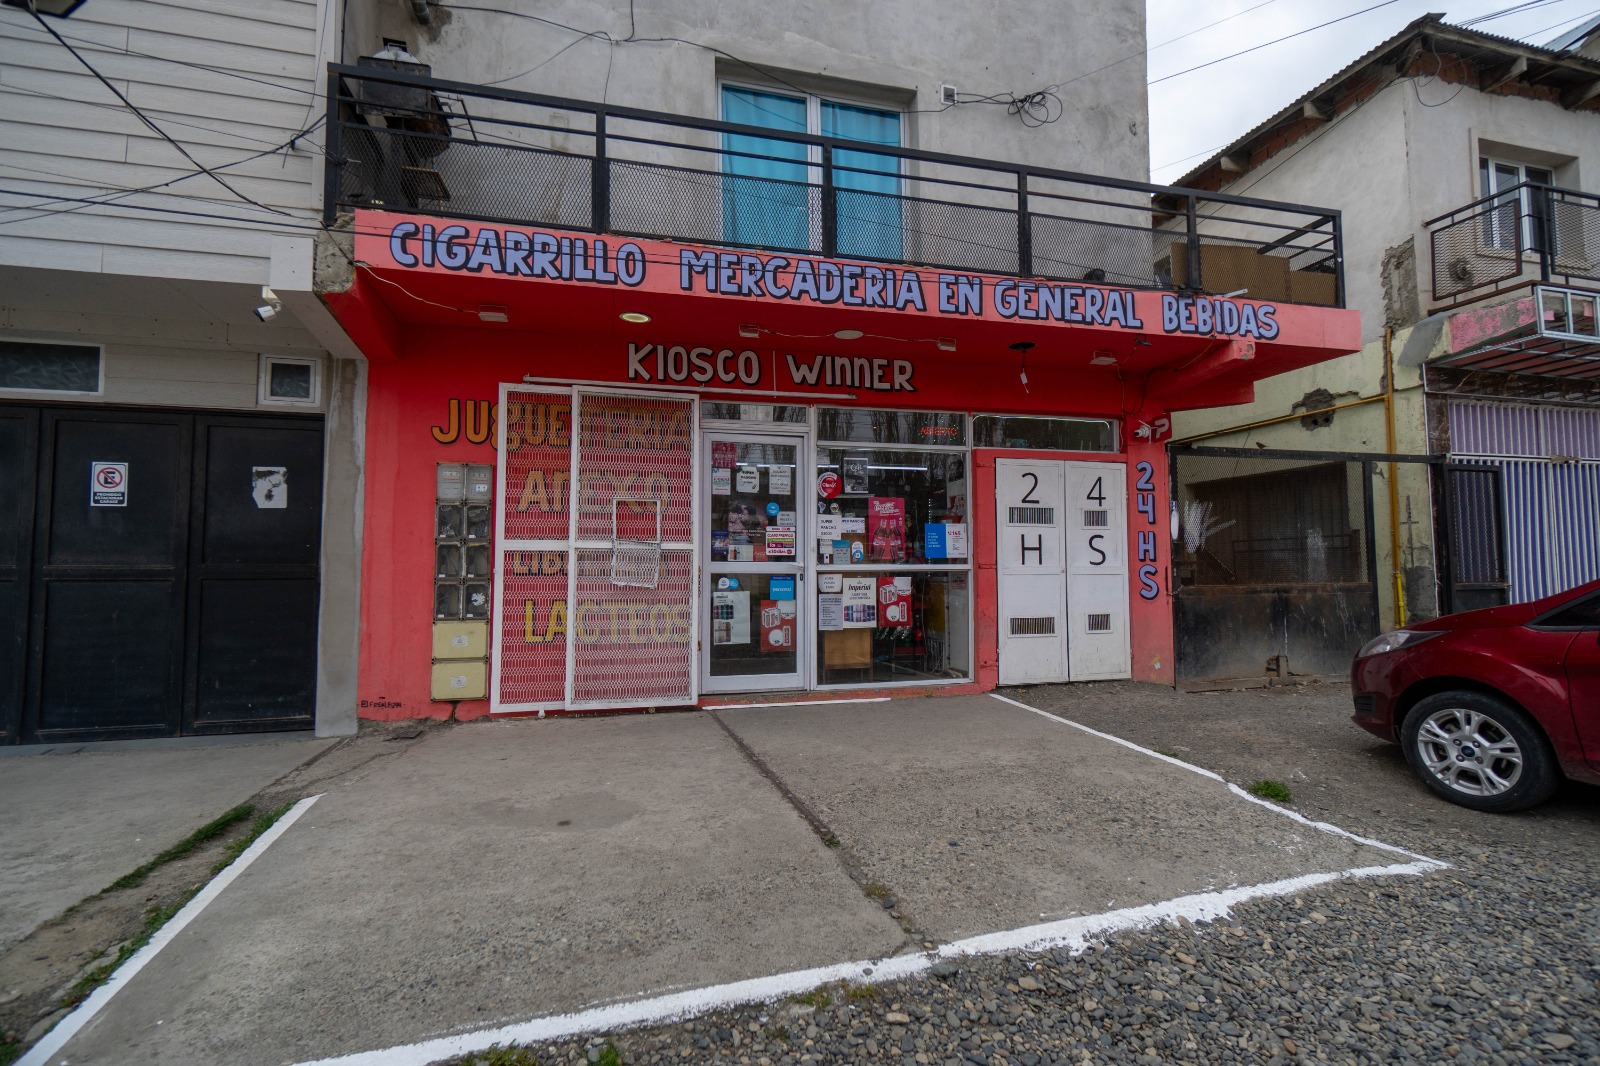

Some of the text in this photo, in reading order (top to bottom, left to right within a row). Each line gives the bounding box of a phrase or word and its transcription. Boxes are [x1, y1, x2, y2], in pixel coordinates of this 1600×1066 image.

[390, 222, 1279, 340] CIGARRILLO MERCADERIA EN GENERAL BEBIDAS
[628, 343, 762, 385] KIOSCO
[1021, 472, 1106, 507] 2 4
[1021, 534, 1106, 565] H S
[523, 599, 691, 645] LACTEOS
